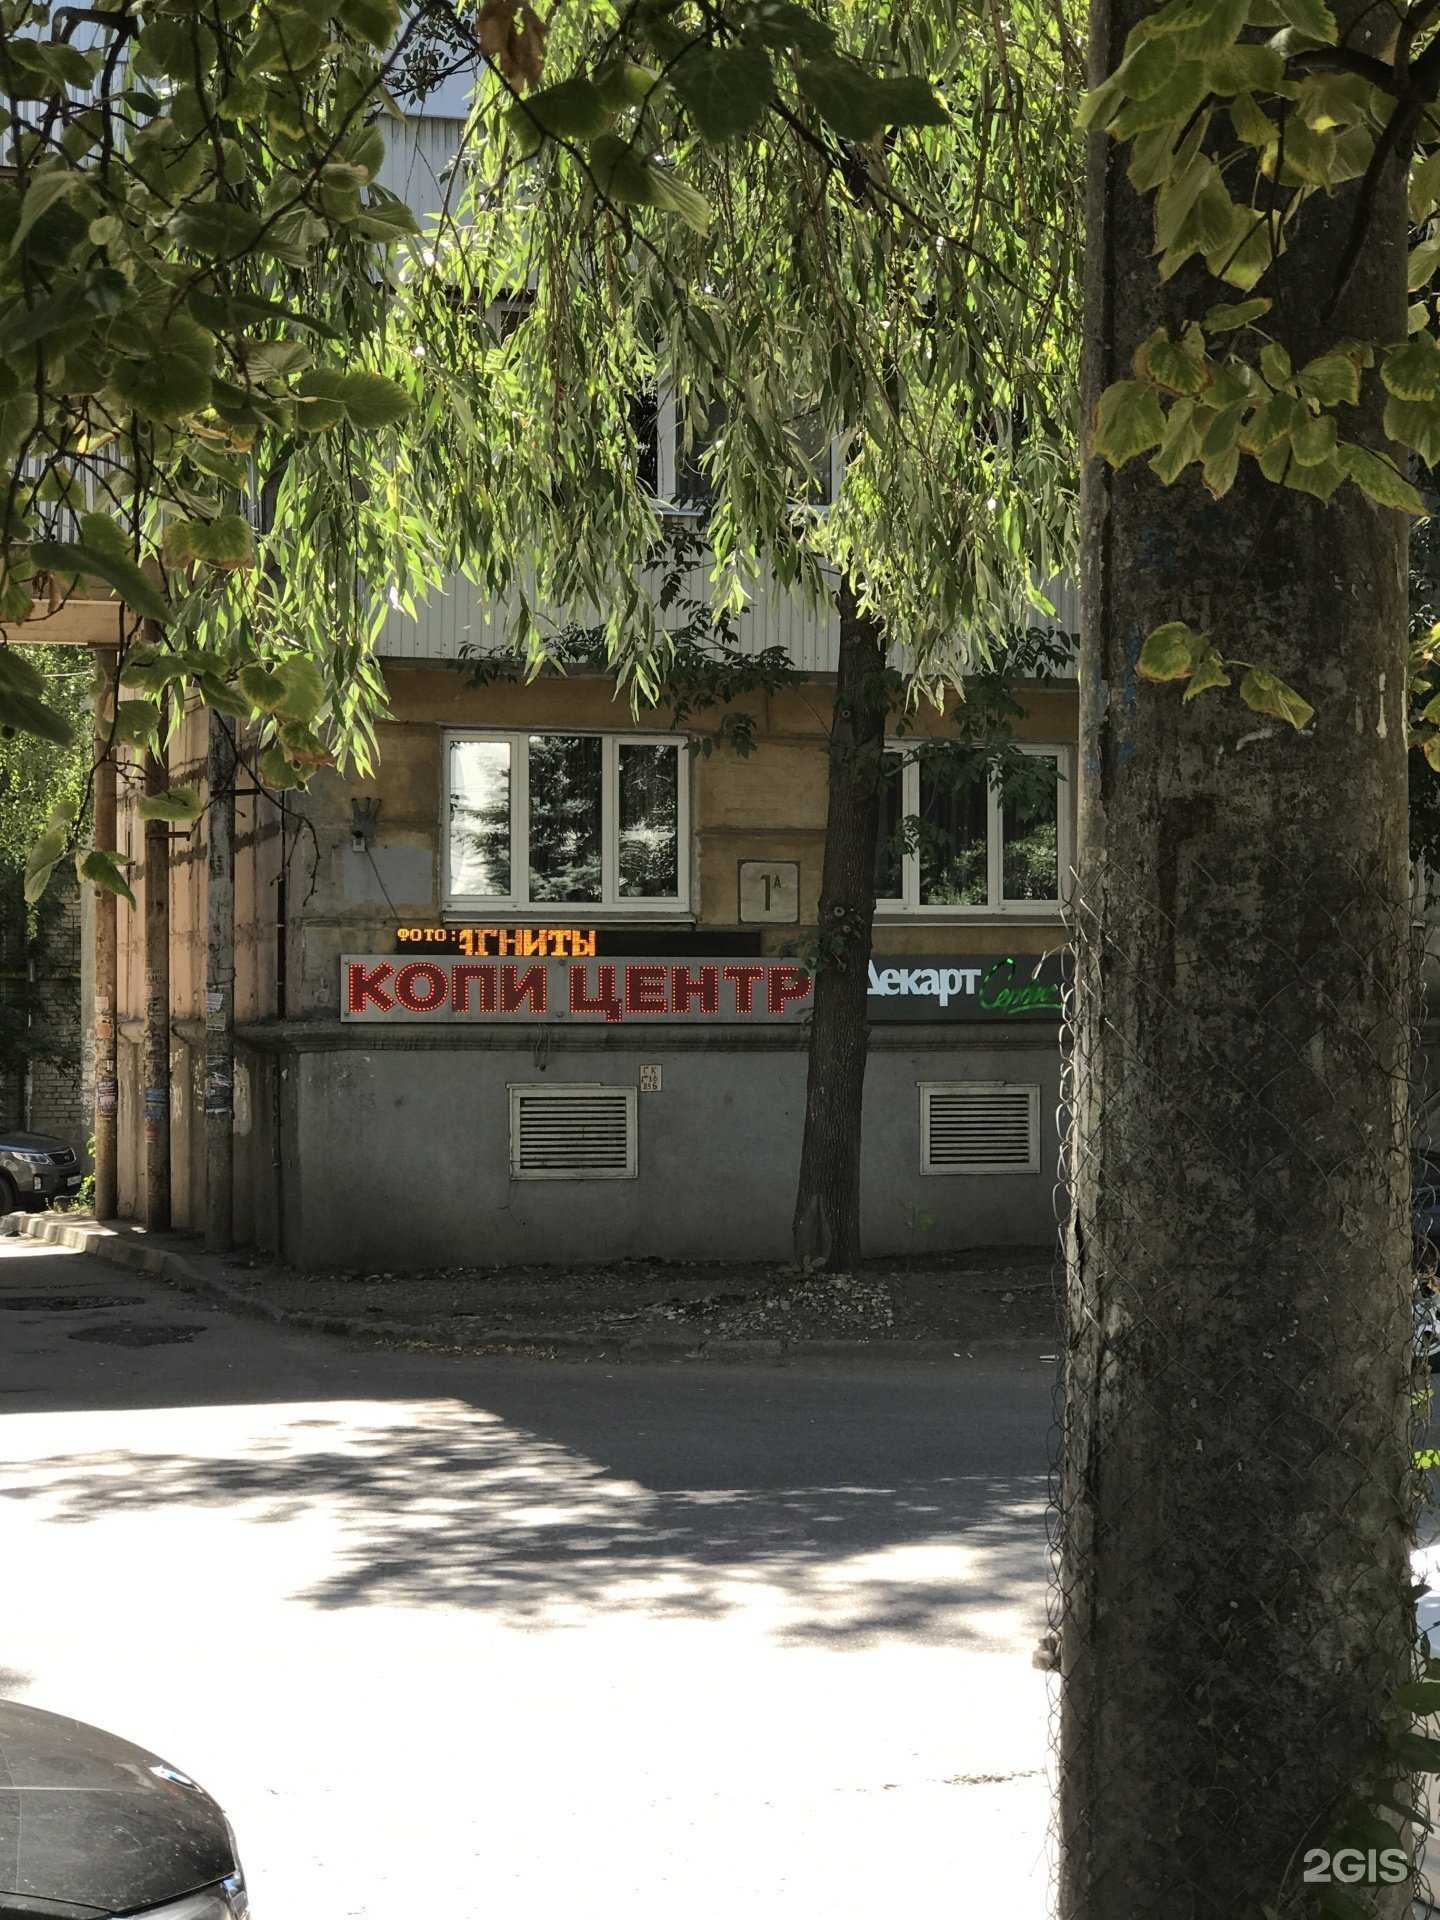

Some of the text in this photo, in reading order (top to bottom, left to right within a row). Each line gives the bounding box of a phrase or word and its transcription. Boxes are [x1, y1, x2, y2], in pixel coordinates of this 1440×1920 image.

[397, 928, 456, 942] ФОТО:
[348, 961, 813, 1022] КОПИ ЦЕНТР
